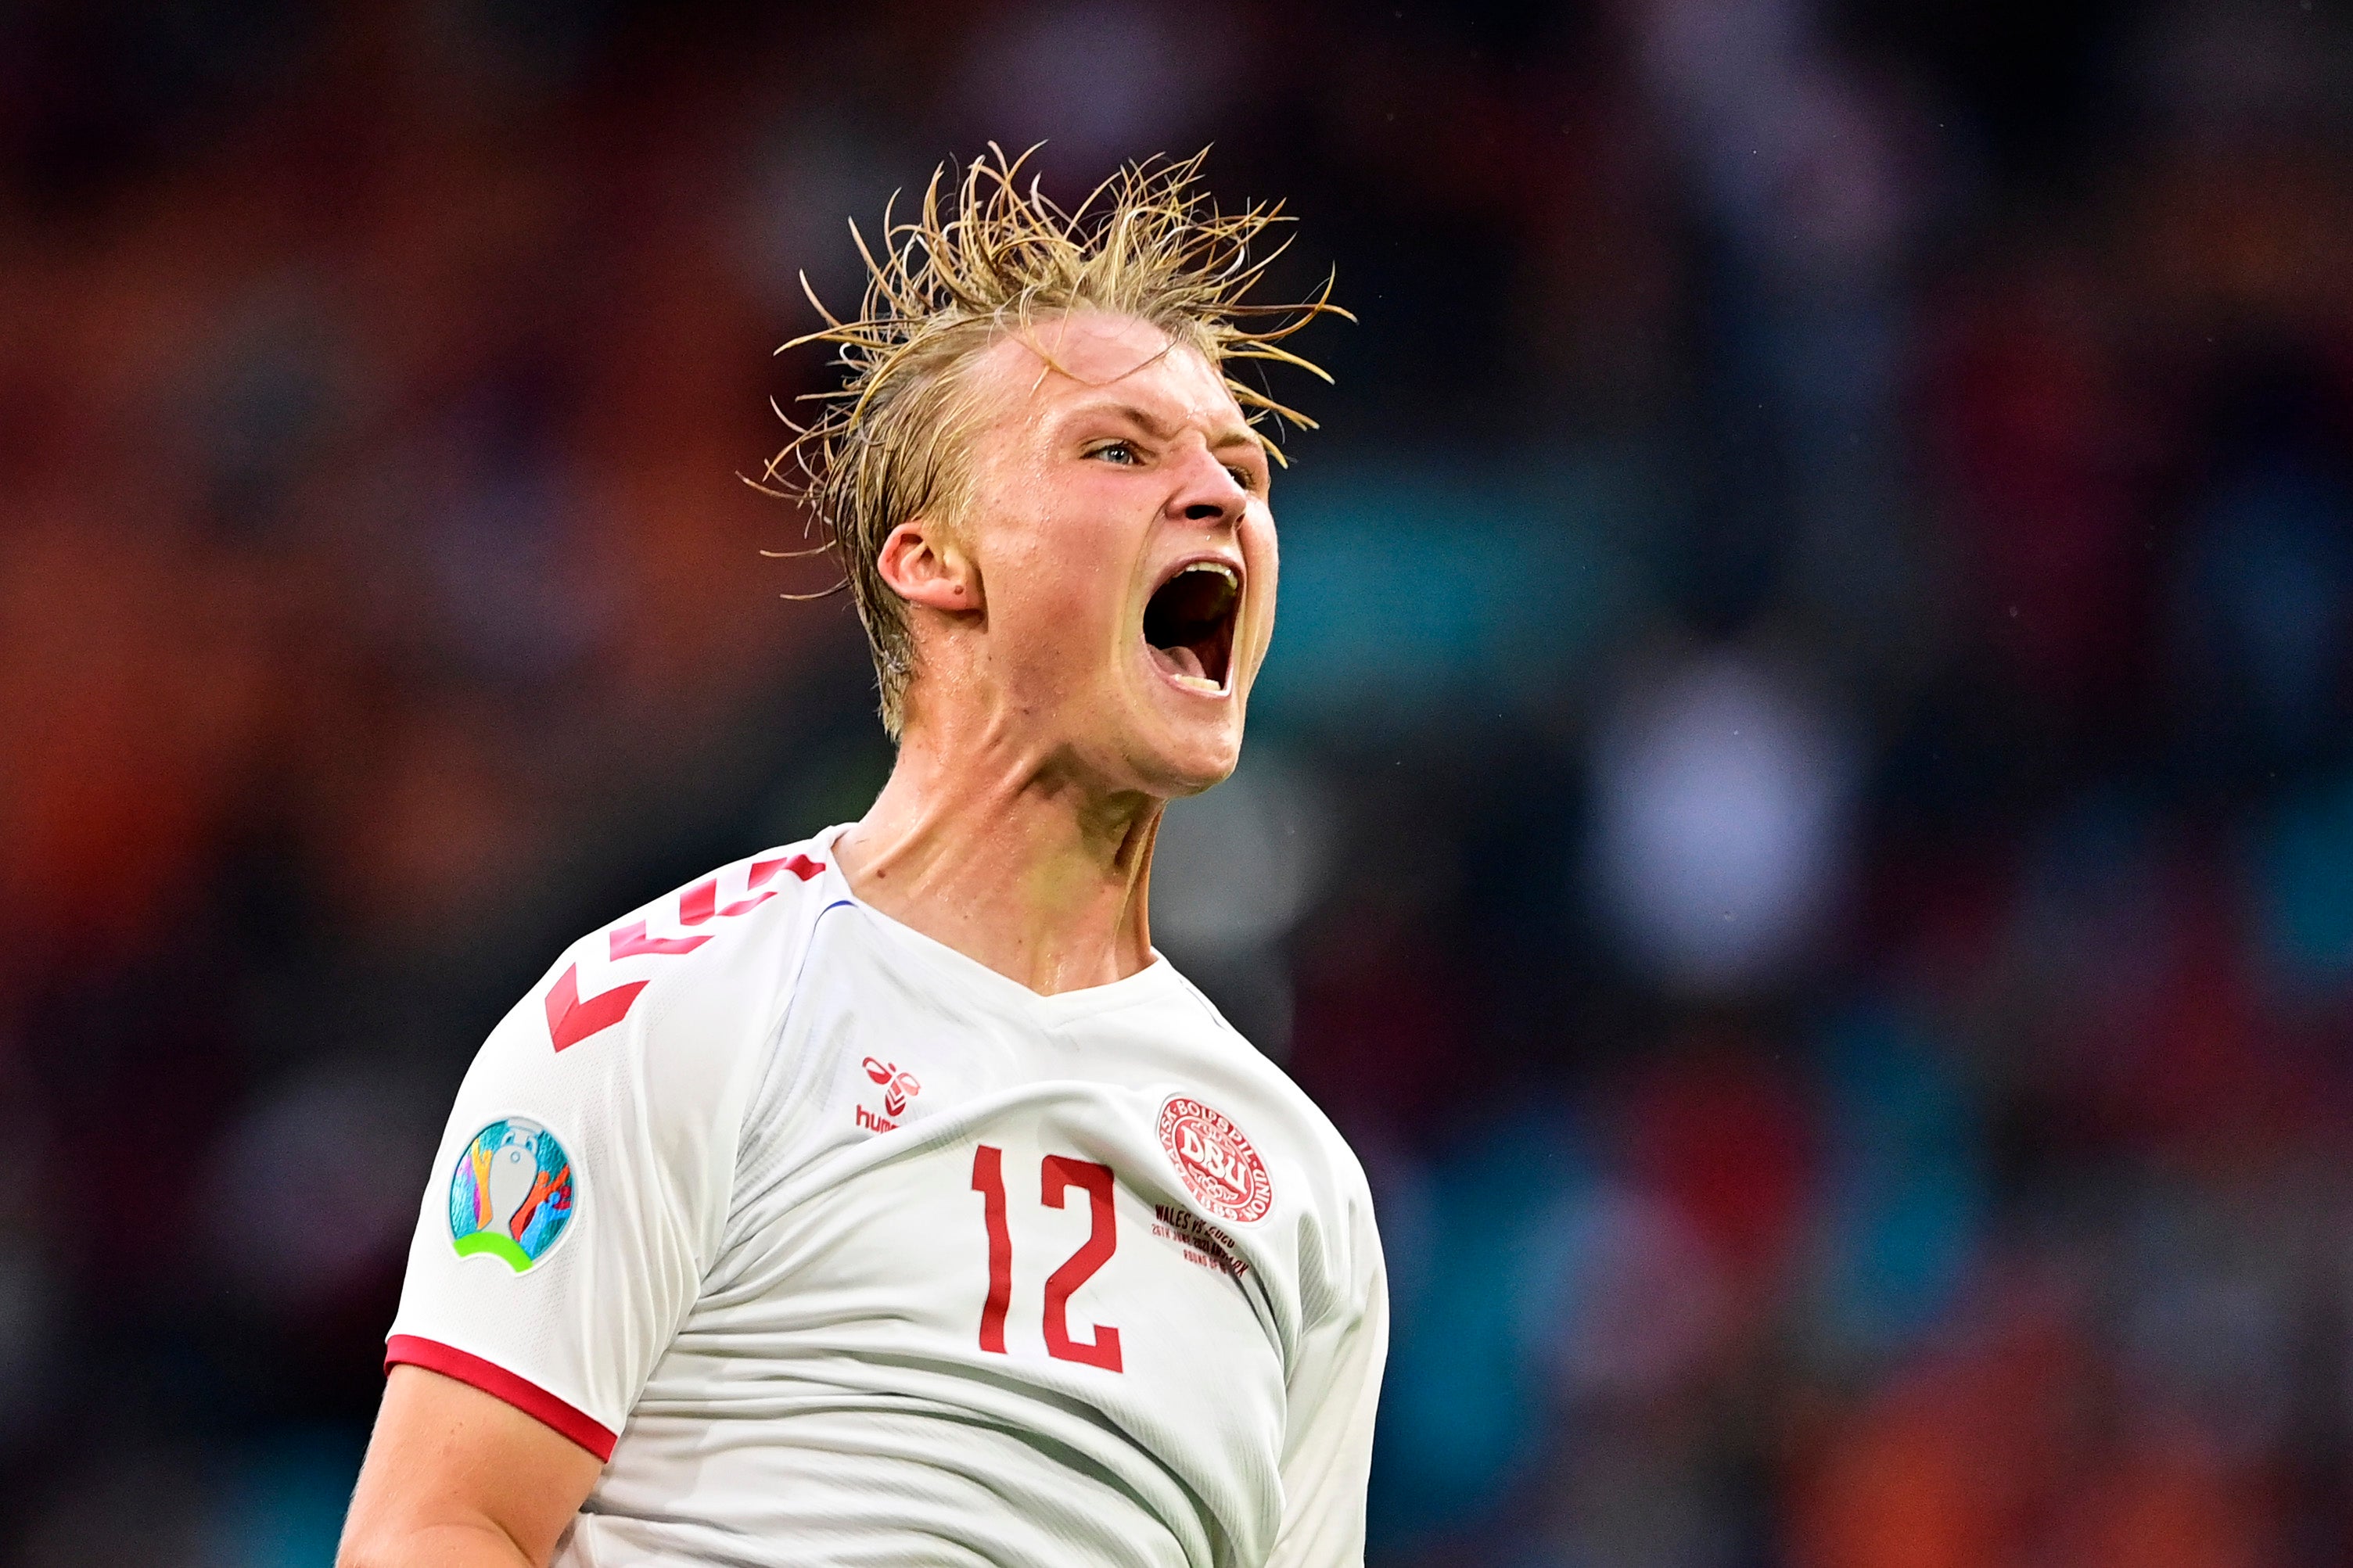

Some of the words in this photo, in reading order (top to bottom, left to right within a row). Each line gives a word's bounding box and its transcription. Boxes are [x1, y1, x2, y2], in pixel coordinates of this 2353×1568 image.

[856, 1103, 900, 1134] hum
[1180, 1125, 1248, 1195] DBU
[1155, 1204, 1191, 1229] WALES
[1191, 1220, 1206, 1233] VS
[1241, 1168, 1270, 1221] UNION
[972, 1143, 1123, 1373] 12
